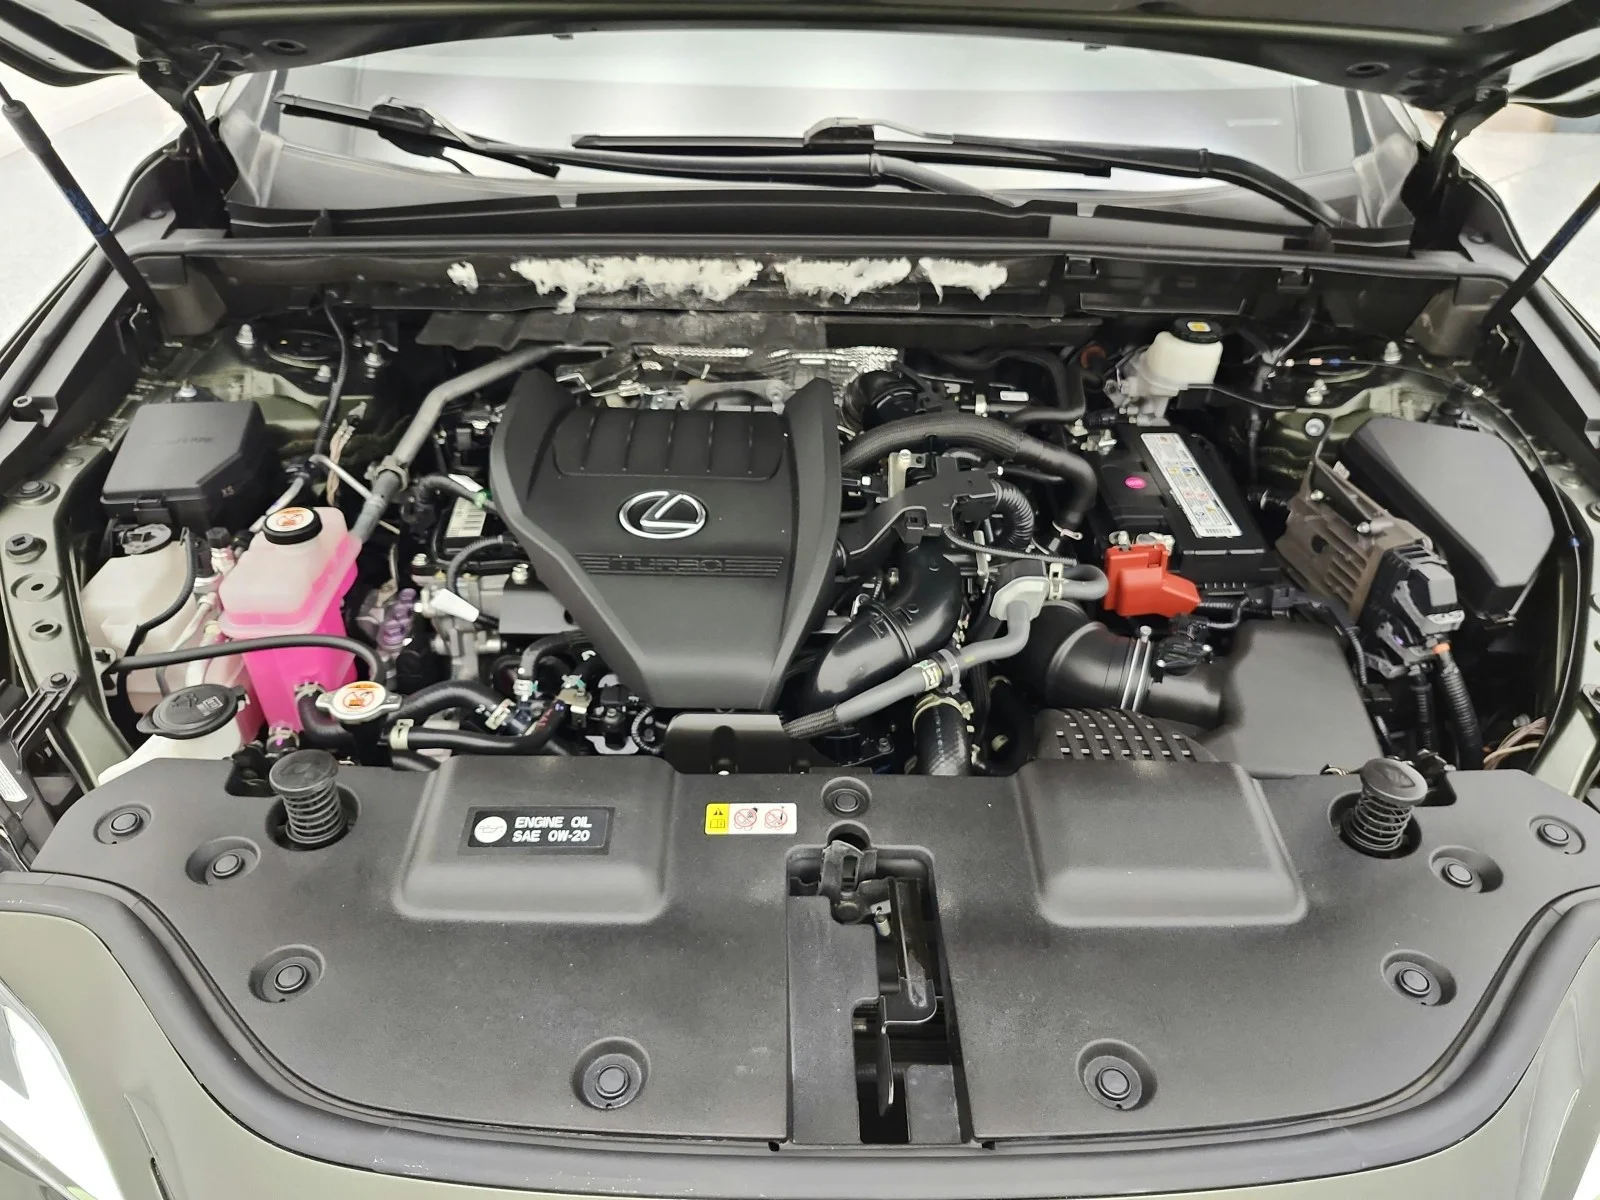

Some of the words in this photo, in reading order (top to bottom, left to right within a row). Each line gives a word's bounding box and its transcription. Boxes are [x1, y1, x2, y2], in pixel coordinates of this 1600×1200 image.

[611, 557, 723, 572] TURBO
[514, 816, 564, 828] ENGINE
[571, 816, 592, 828] OIL
[512, 830, 541, 842] SAE
[547, 830, 590, 842] 0W-20
